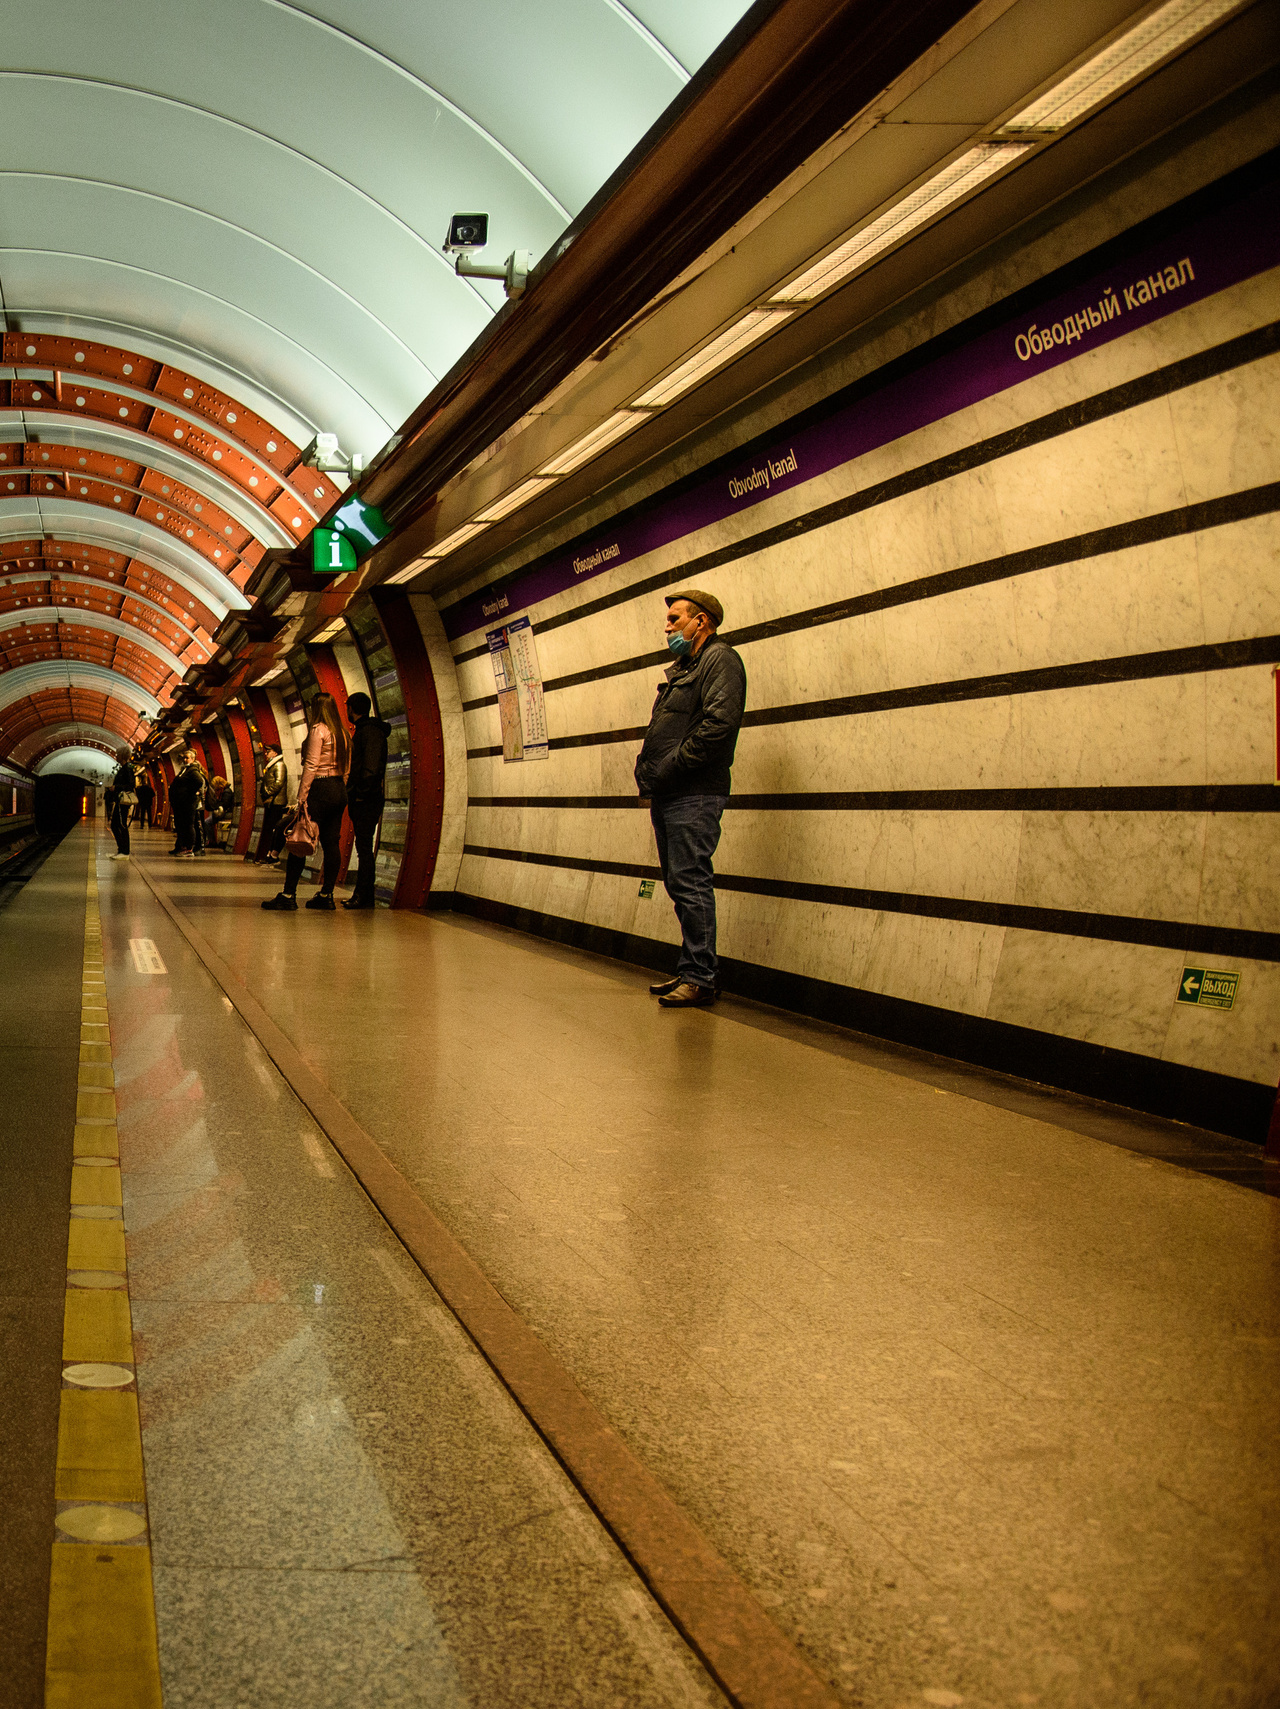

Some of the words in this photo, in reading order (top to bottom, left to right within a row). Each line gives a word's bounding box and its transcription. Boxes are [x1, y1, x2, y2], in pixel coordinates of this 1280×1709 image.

[1014, 287, 1122, 361] Обводный
[1122, 257, 1196, 311] канал
[728, 467, 770, 499] Obvodny
[767, 448, 798, 480] kanal
[573, 548, 603, 574] Обводный
[601, 543, 621, 562] канал
[1203, 980, 1235, 998] ВЫХОД
